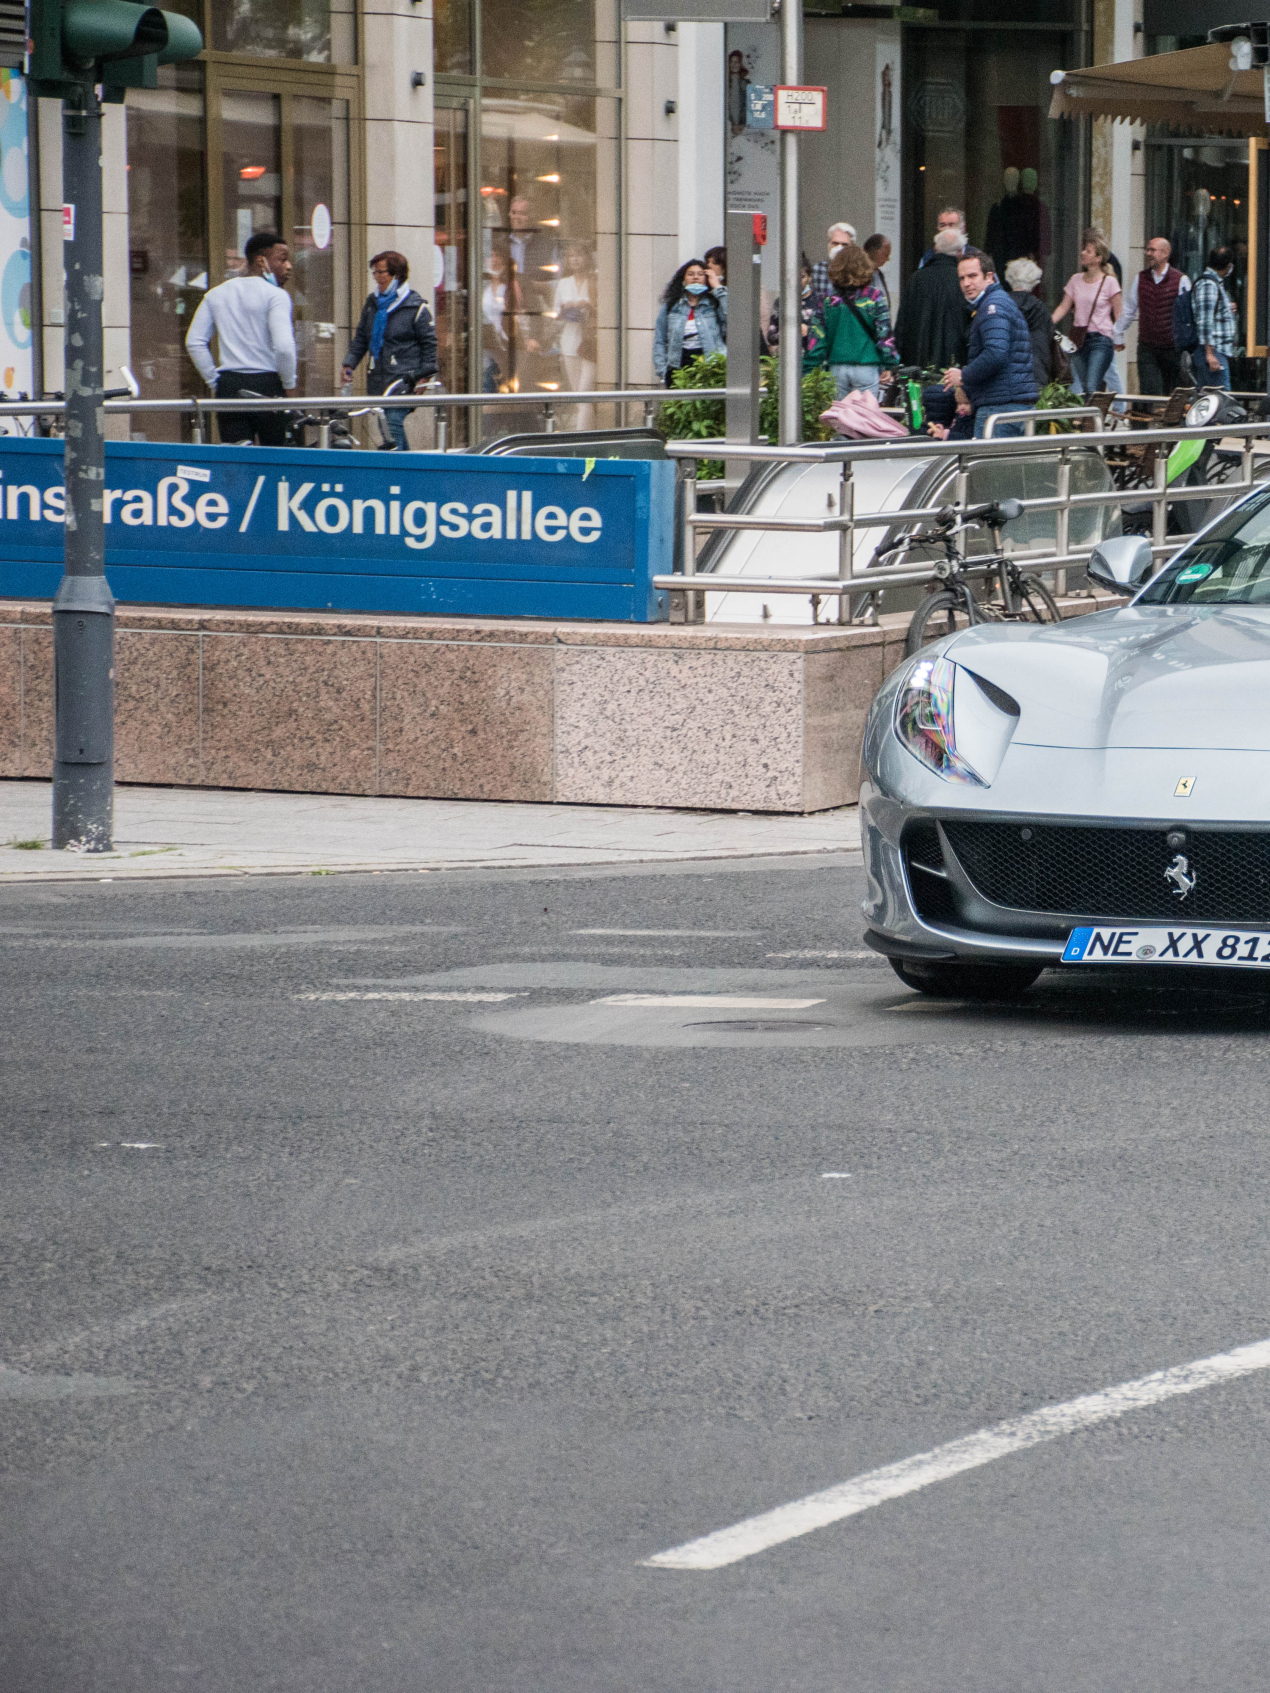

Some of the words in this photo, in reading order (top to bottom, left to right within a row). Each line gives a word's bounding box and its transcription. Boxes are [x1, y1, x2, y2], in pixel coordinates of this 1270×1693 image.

[786, 91, 814, 102] H200
[277, 482, 603, 550] Königsallee
[1071, 947, 1081, 956] D
[1087, 931, 1139, 957] NE
[1158, 931, 1212, 959] XX
